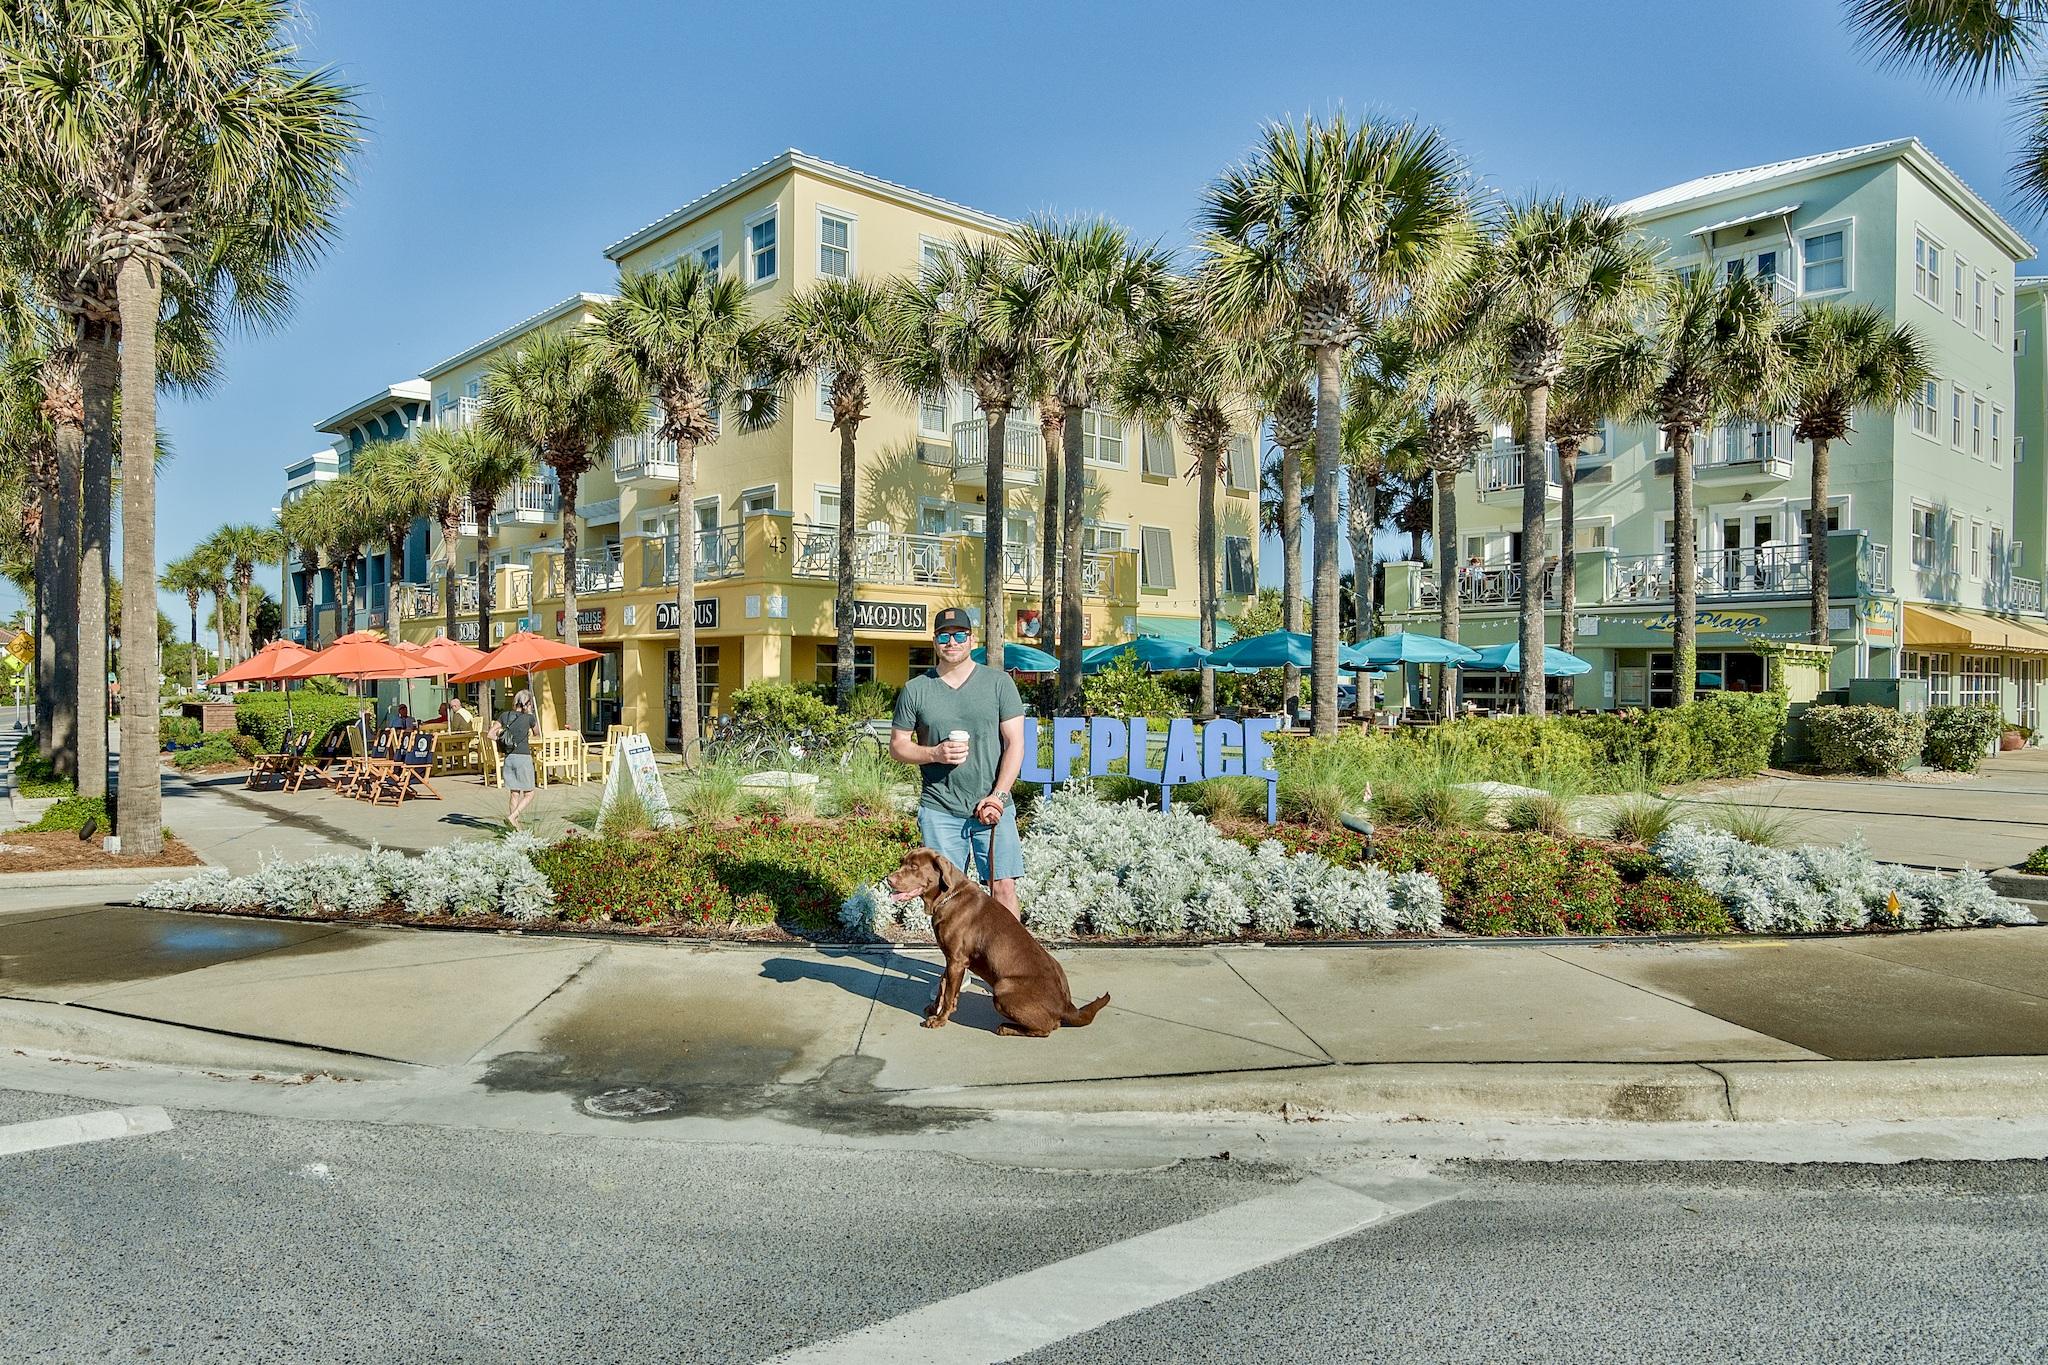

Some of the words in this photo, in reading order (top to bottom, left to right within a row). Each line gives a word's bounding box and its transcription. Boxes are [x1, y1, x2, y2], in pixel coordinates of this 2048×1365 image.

[769, 536, 787, 553] 45
[577, 611, 602, 624] NRISE
[670, 604, 713, 626] MUS
[577, 623, 593, 632] OFFEE
[1021, 717, 1278, 784] LFPLACE
